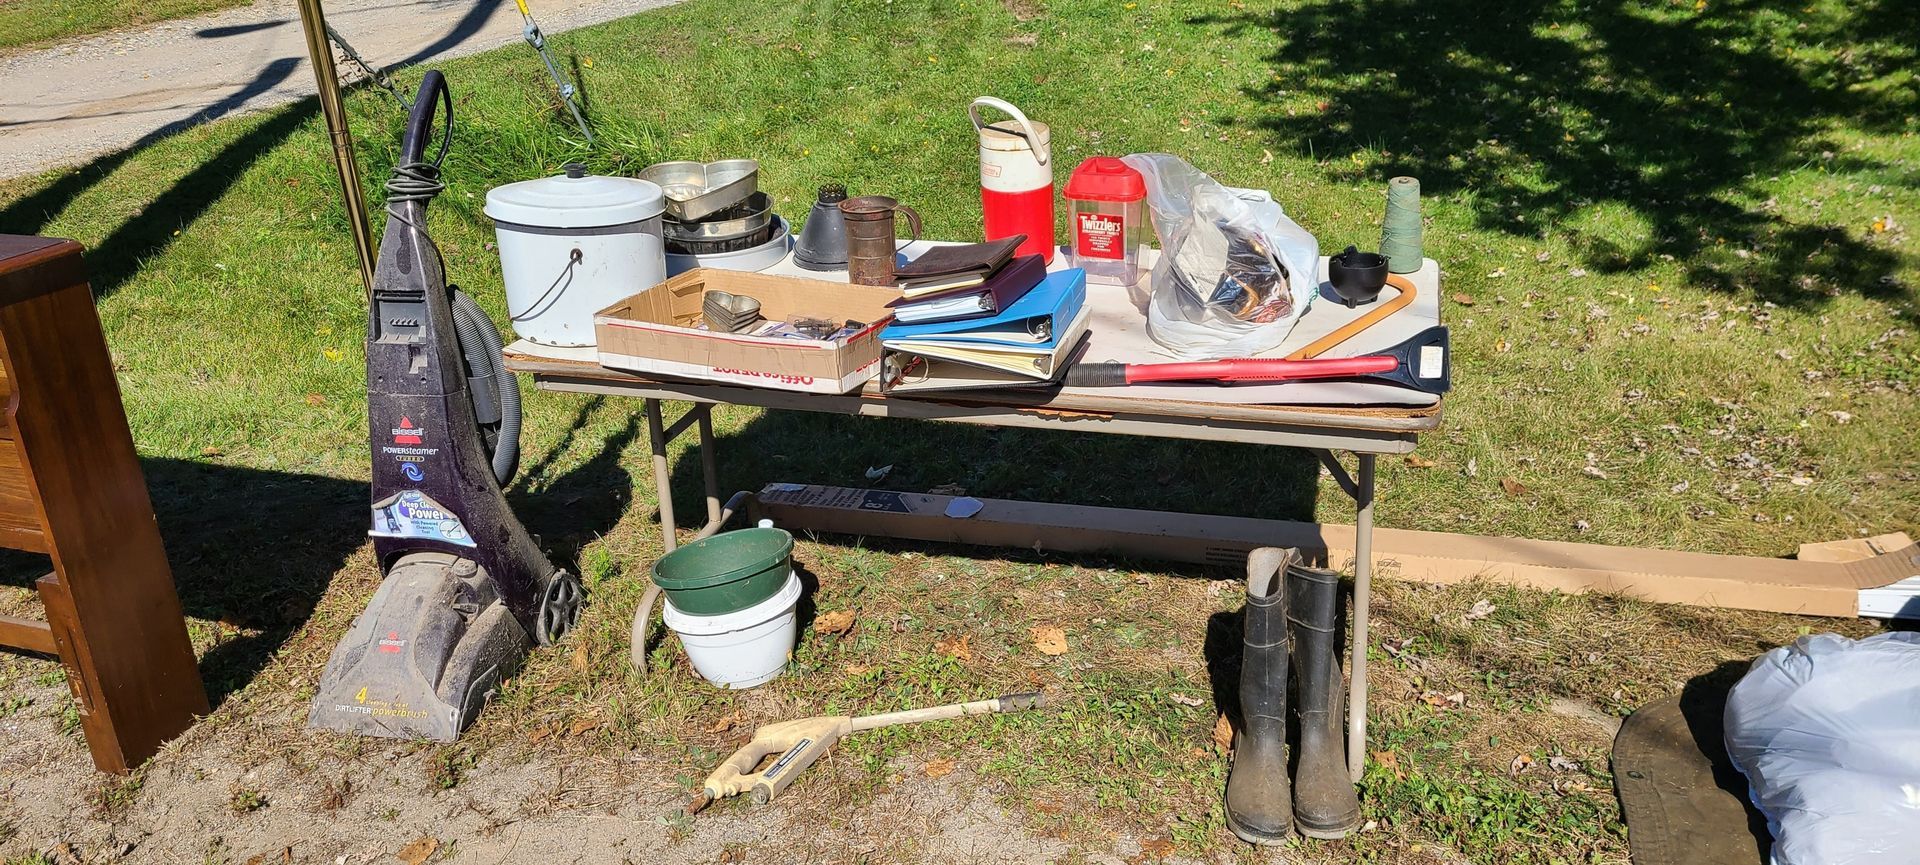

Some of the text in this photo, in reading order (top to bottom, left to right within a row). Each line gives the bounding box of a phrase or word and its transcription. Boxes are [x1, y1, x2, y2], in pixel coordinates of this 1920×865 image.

[1080, 215, 1121, 232] Twizzlers
[402, 501, 420, 509] Deep
[355, 686, 368, 704] 4
[372, 707, 428, 719] powerbrush
